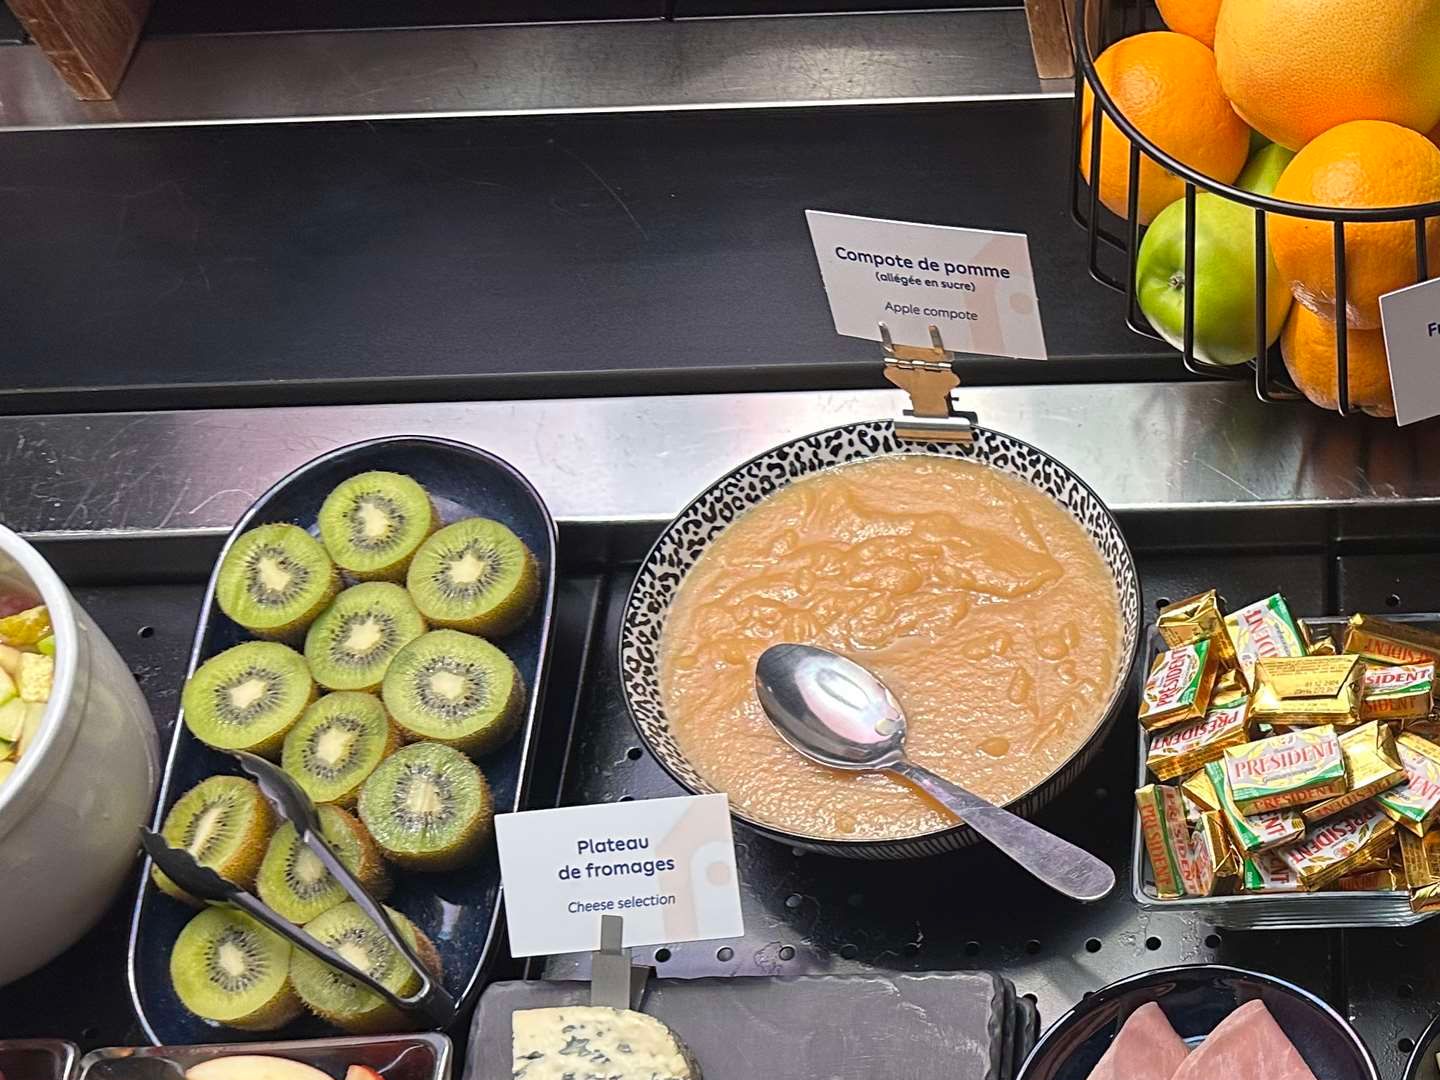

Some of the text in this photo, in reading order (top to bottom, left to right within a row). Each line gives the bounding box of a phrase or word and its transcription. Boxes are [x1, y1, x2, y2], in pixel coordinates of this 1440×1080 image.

[835, 246, 1010, 279] Compote de pomme
[875, 270, 976, 292] (allégée en sucre)
[884, 302, 978, 322] Apple compote
[578, 837, 650, 854] Plateau
[558, 858, 675, 880] de fromages
[568, 894, 676, 914] Cheese selection
